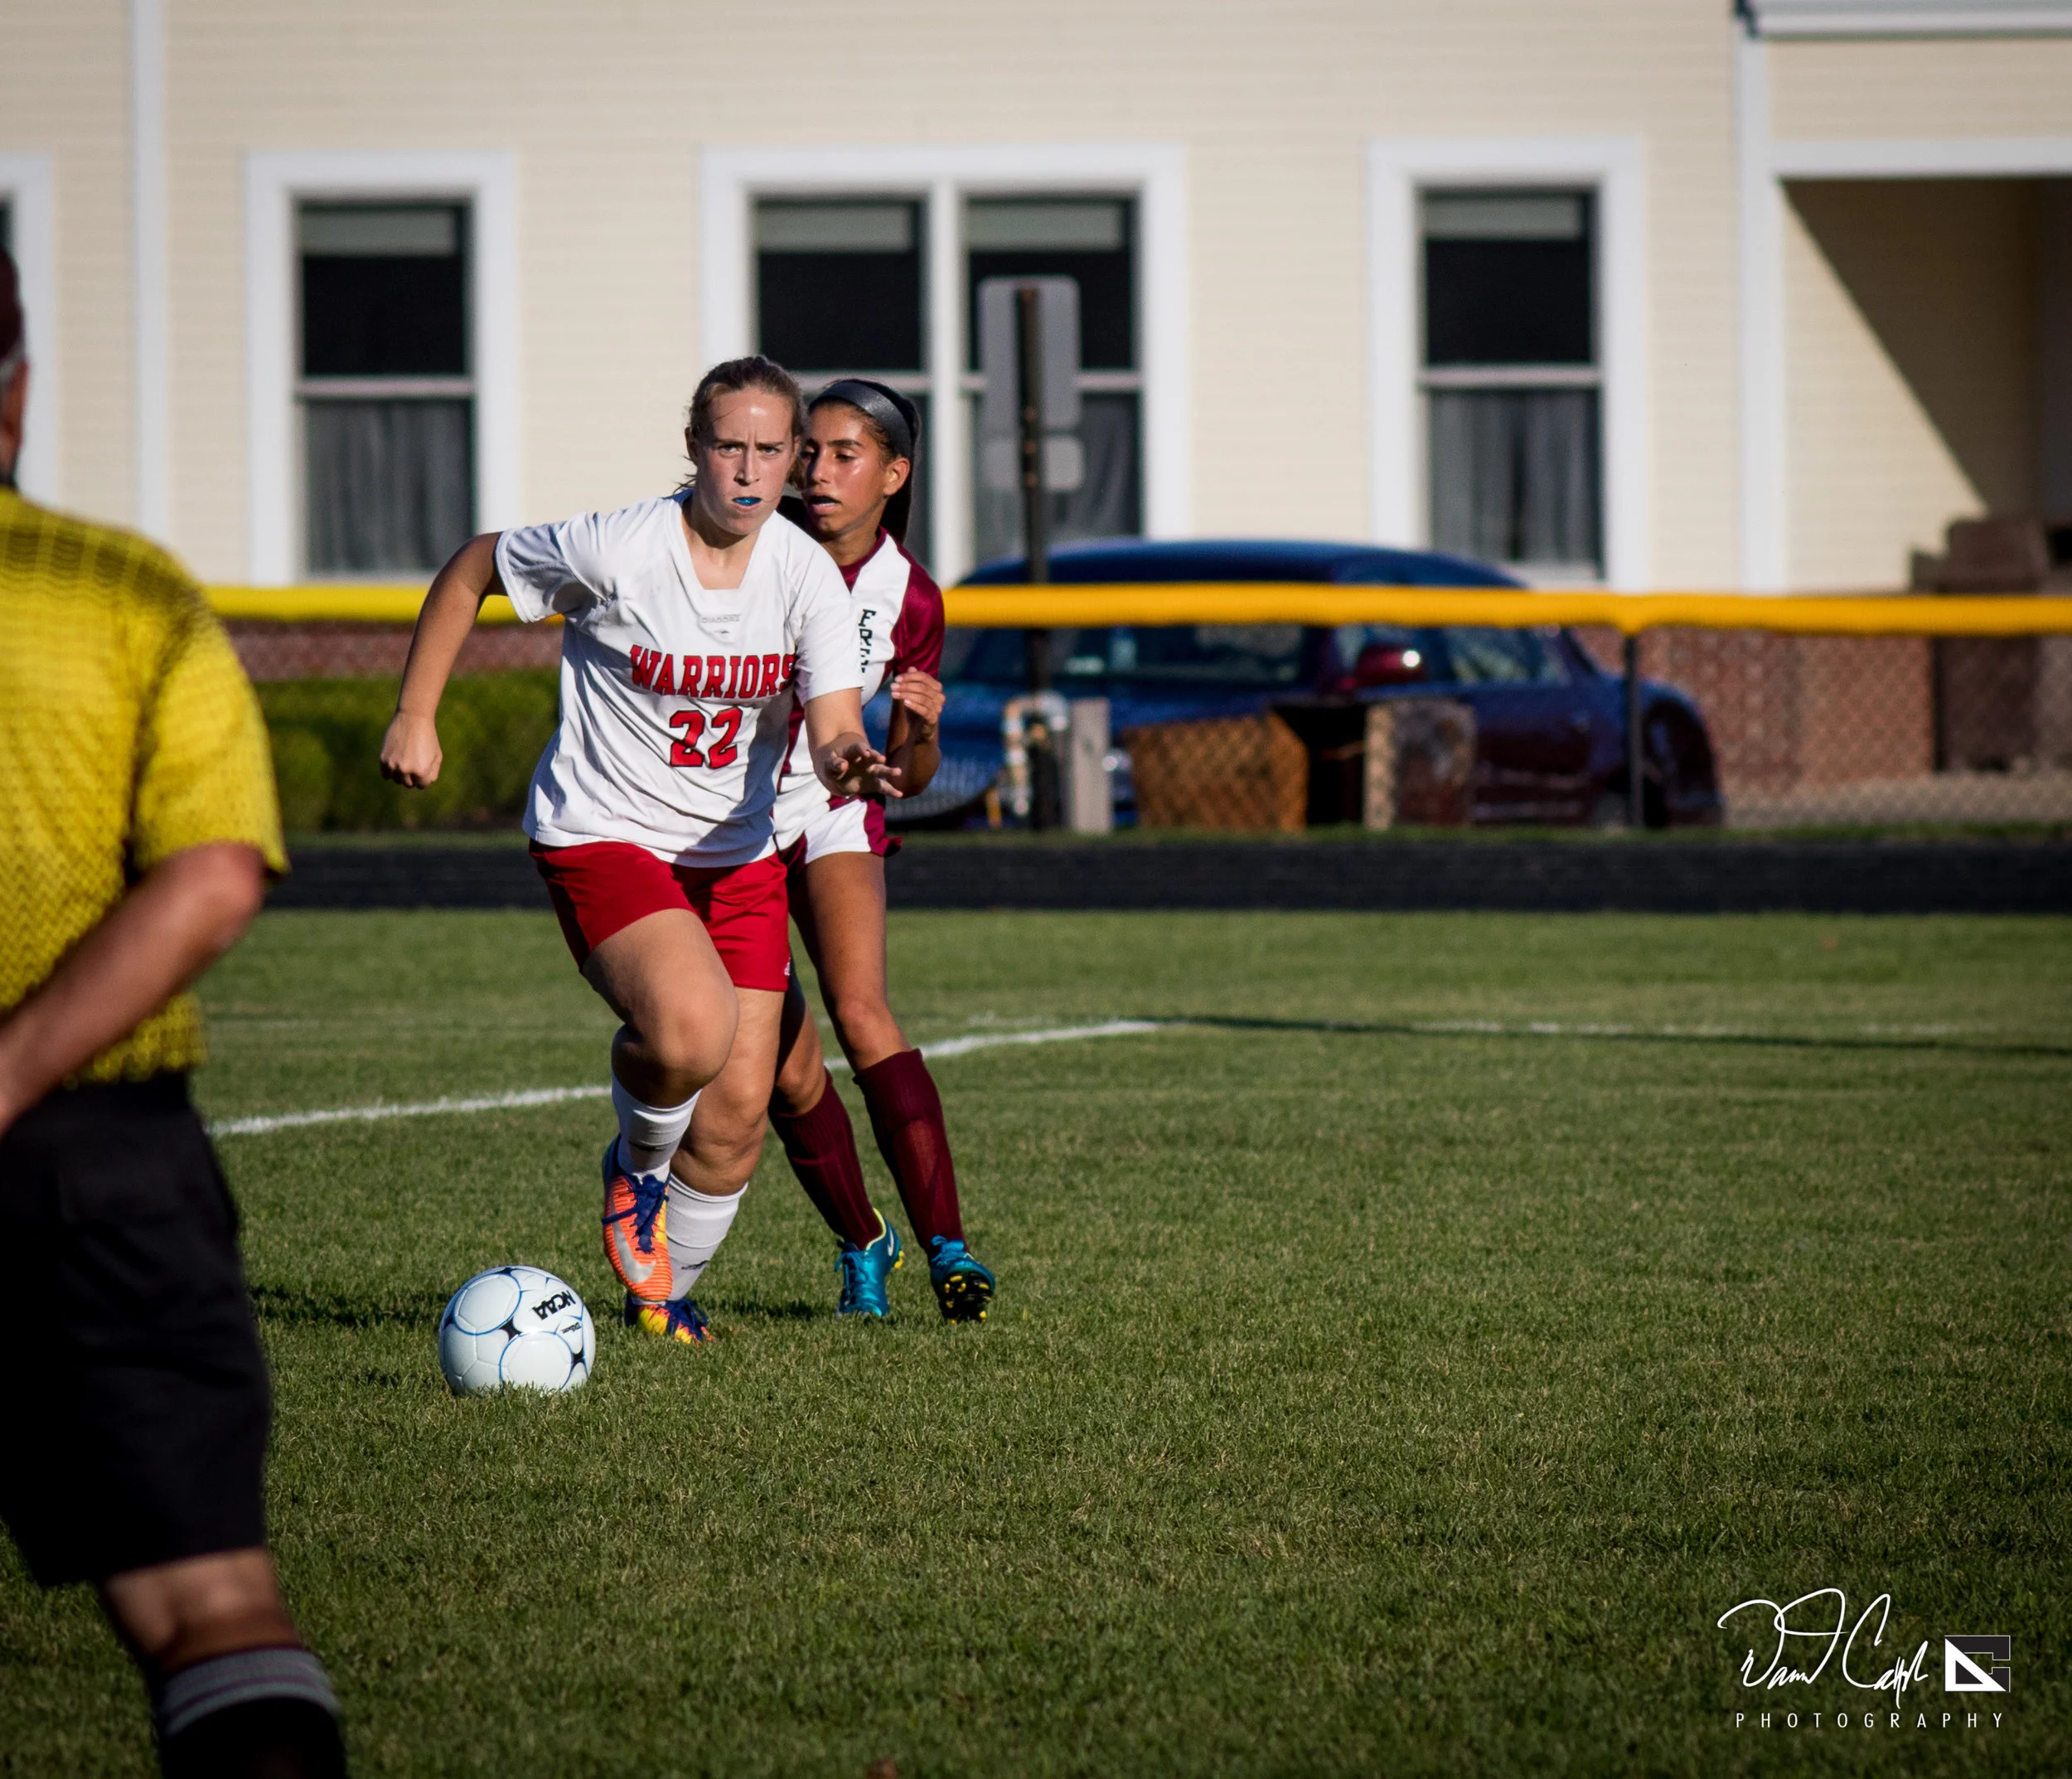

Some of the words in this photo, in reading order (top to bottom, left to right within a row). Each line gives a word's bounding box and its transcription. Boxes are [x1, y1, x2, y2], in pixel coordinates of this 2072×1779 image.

[630, 644, 796, 700] WARRIORS
[669, 707, 743, 769] 22
[531, 1290, 577, 1321] NCAA
